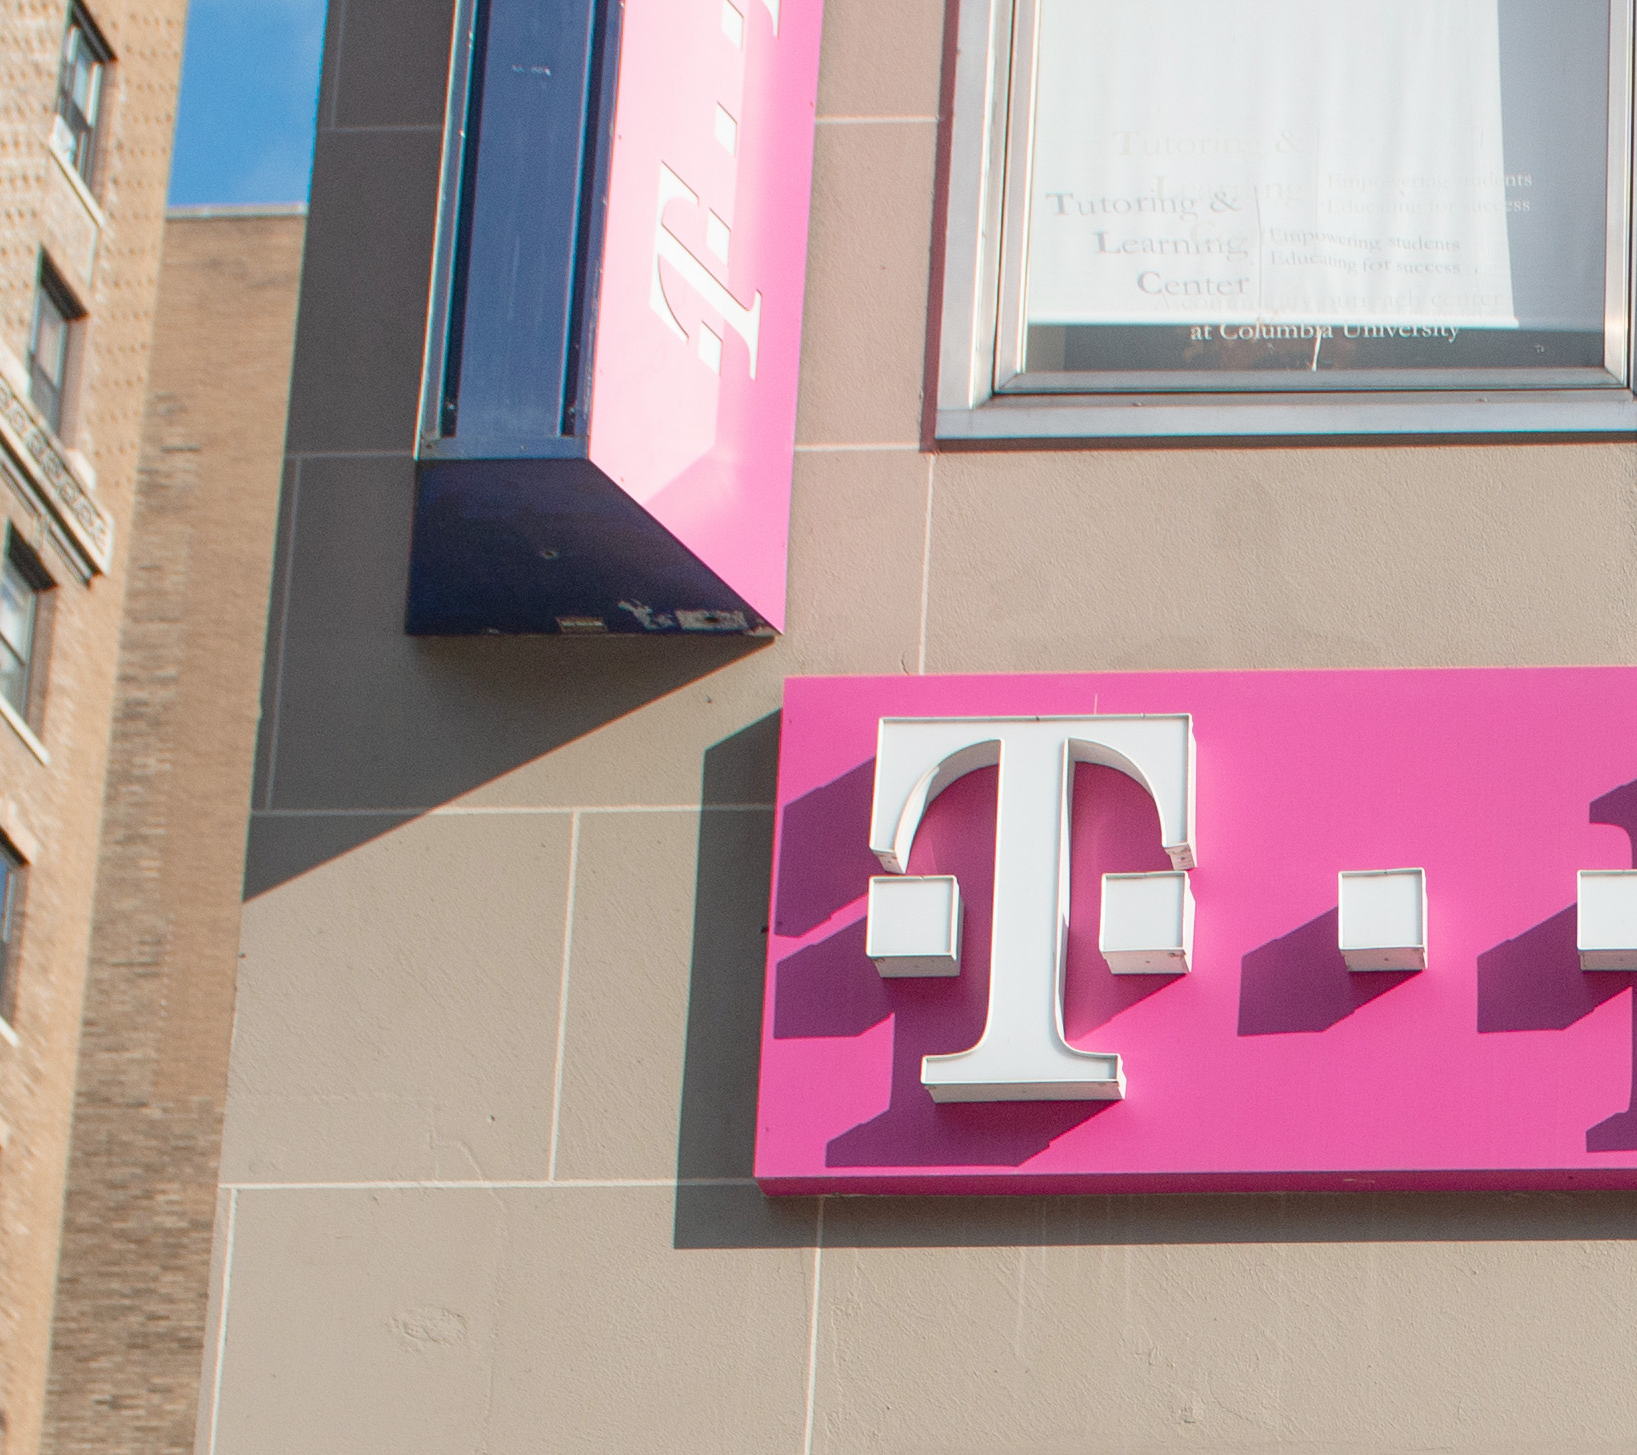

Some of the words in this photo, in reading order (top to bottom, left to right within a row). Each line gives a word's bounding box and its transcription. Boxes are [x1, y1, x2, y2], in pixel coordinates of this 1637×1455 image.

[1136, 270, 1251, 297] Center
[1190, 324, 1213, 341] at
[1219, 320, 1334, 342] Columbia
[1342, 320, 1461, 343] University
